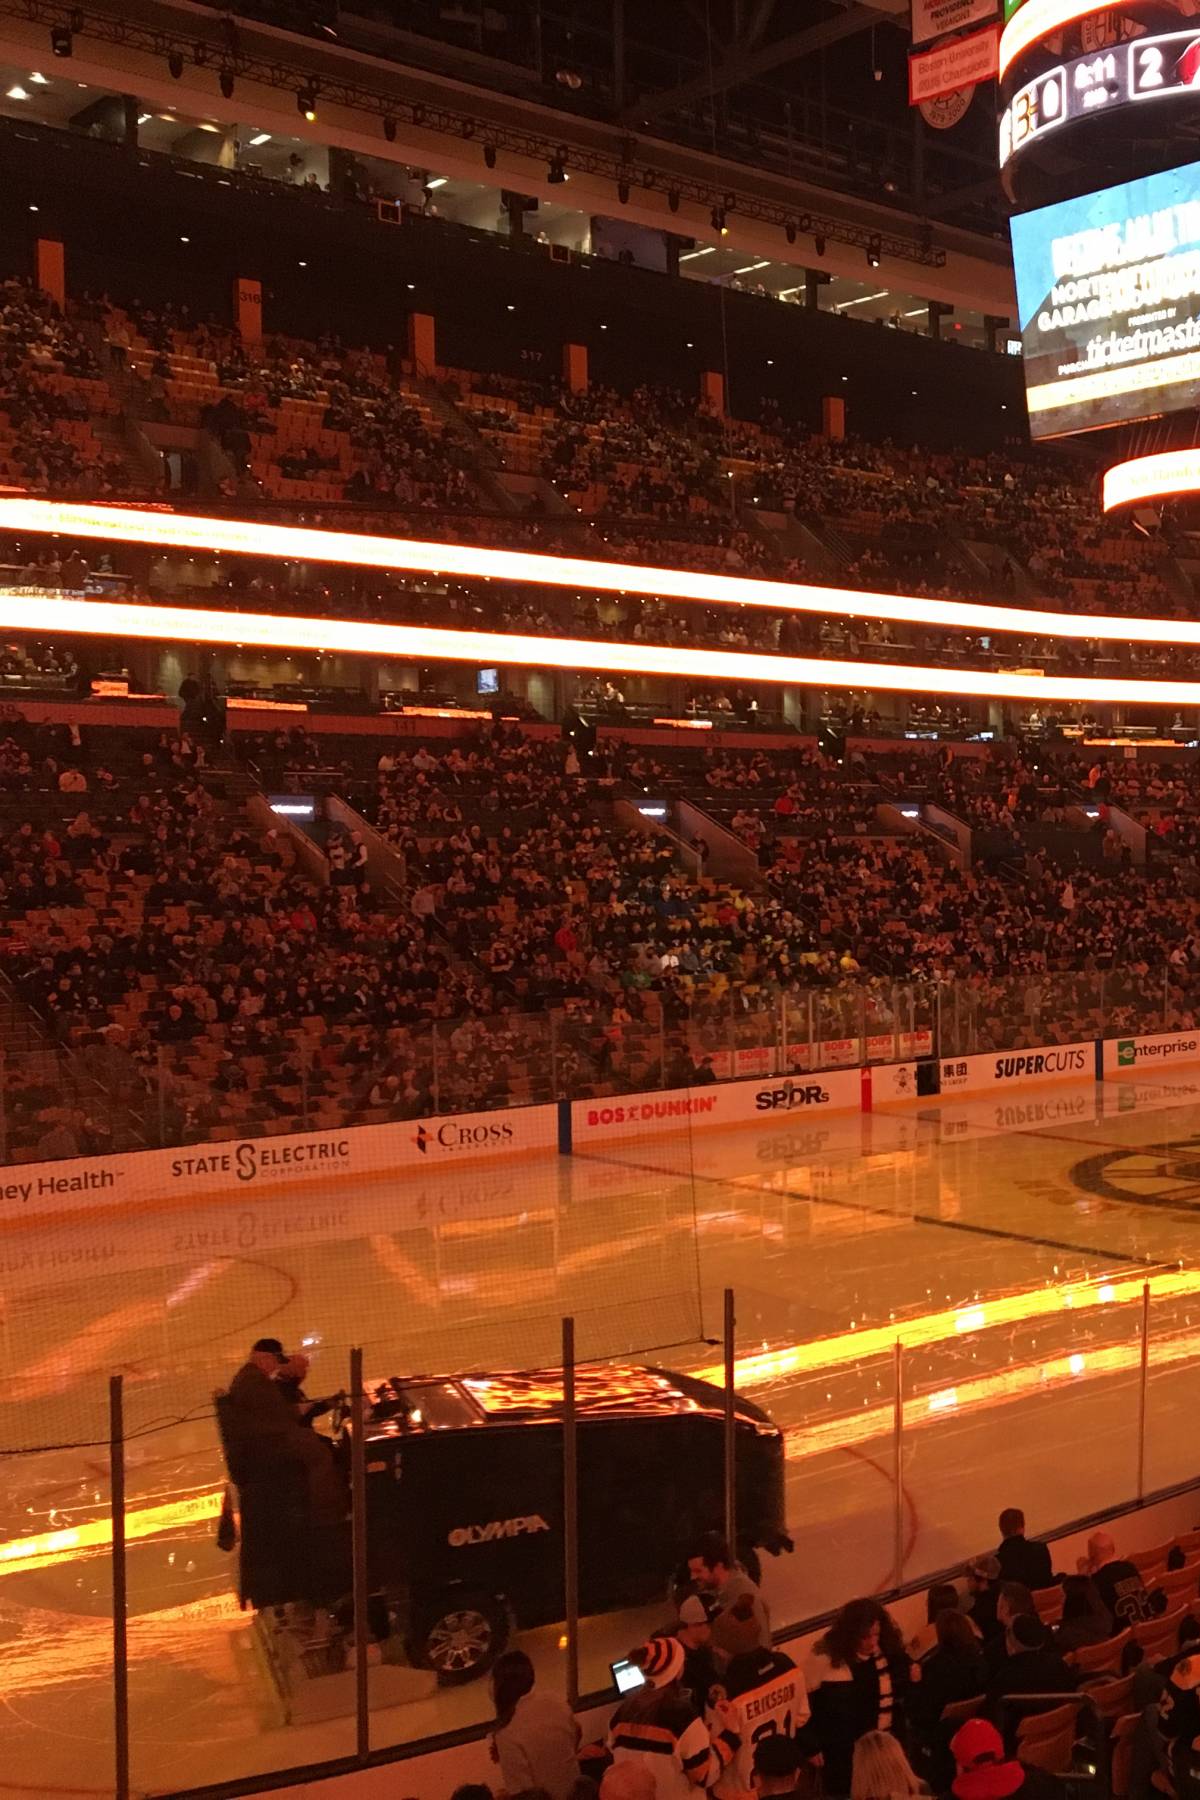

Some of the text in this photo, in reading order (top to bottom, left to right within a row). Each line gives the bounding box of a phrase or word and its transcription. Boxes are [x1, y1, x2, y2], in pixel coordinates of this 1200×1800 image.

[918, 40, 989, 74] Boston University
[942, 58, 990, 83] Champions
[1139, 47, 1162, 88] 2
[1043, 79, 1060, 118] 0
[520, 349, 543, 361] 317
[1122, 1038, 1197, 1060] enterprise
[994, 1050, 1085, 1079] SUPERCUTS
[588, 1096, 717, 1126] BOS DUNKIN'
[437, 1122, 514, 1147] CROSS
[172, 1155, 230, 1177] STATE
[260, 1159, 351, 1178] CORPORATION
[38, 1169, 114, 1196] Health
[448, 1514, 551, 1546] OLYMPIA
[746, 1683, 795, 1720] ERIKSSON
